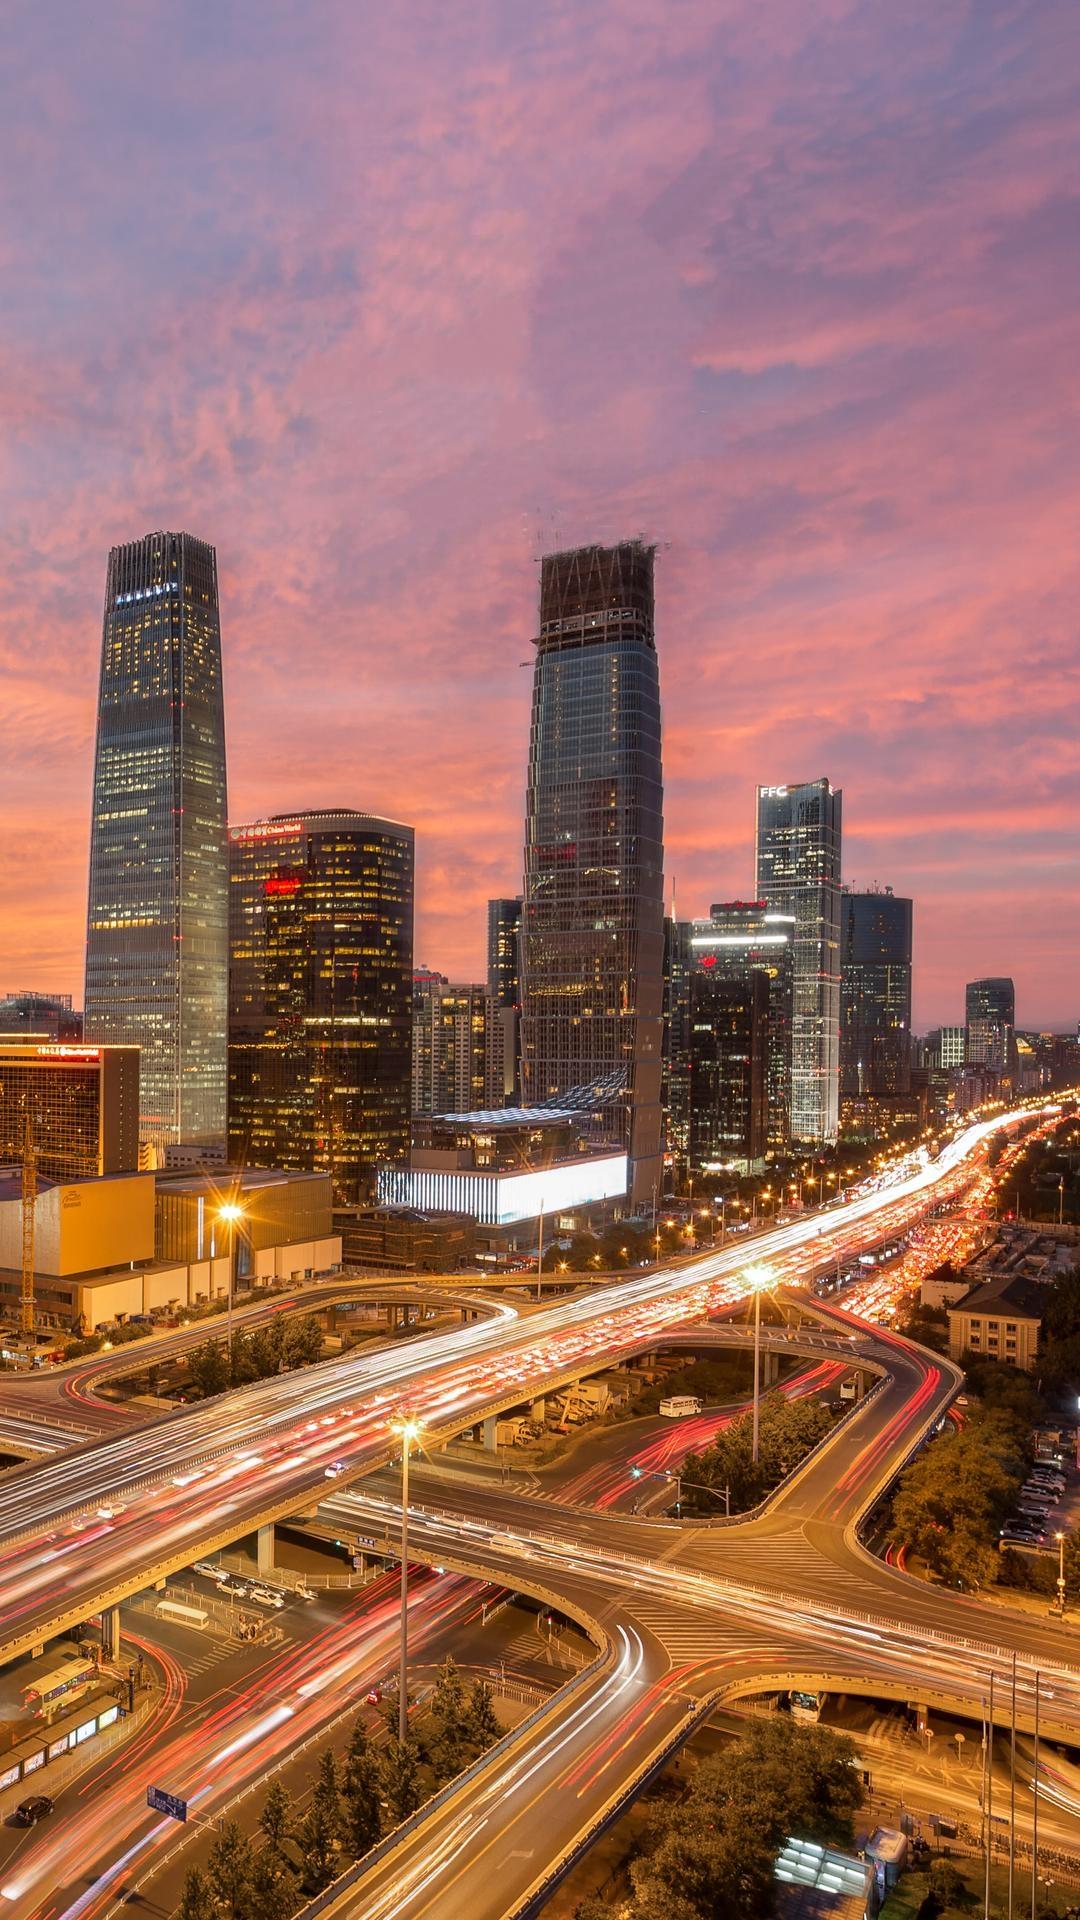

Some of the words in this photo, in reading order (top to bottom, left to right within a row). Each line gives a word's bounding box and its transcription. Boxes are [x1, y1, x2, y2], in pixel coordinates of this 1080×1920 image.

[760, 786, 787, 798] FFC
[267, 825, 284, 834] China
[284, 823, 301, 832] World
